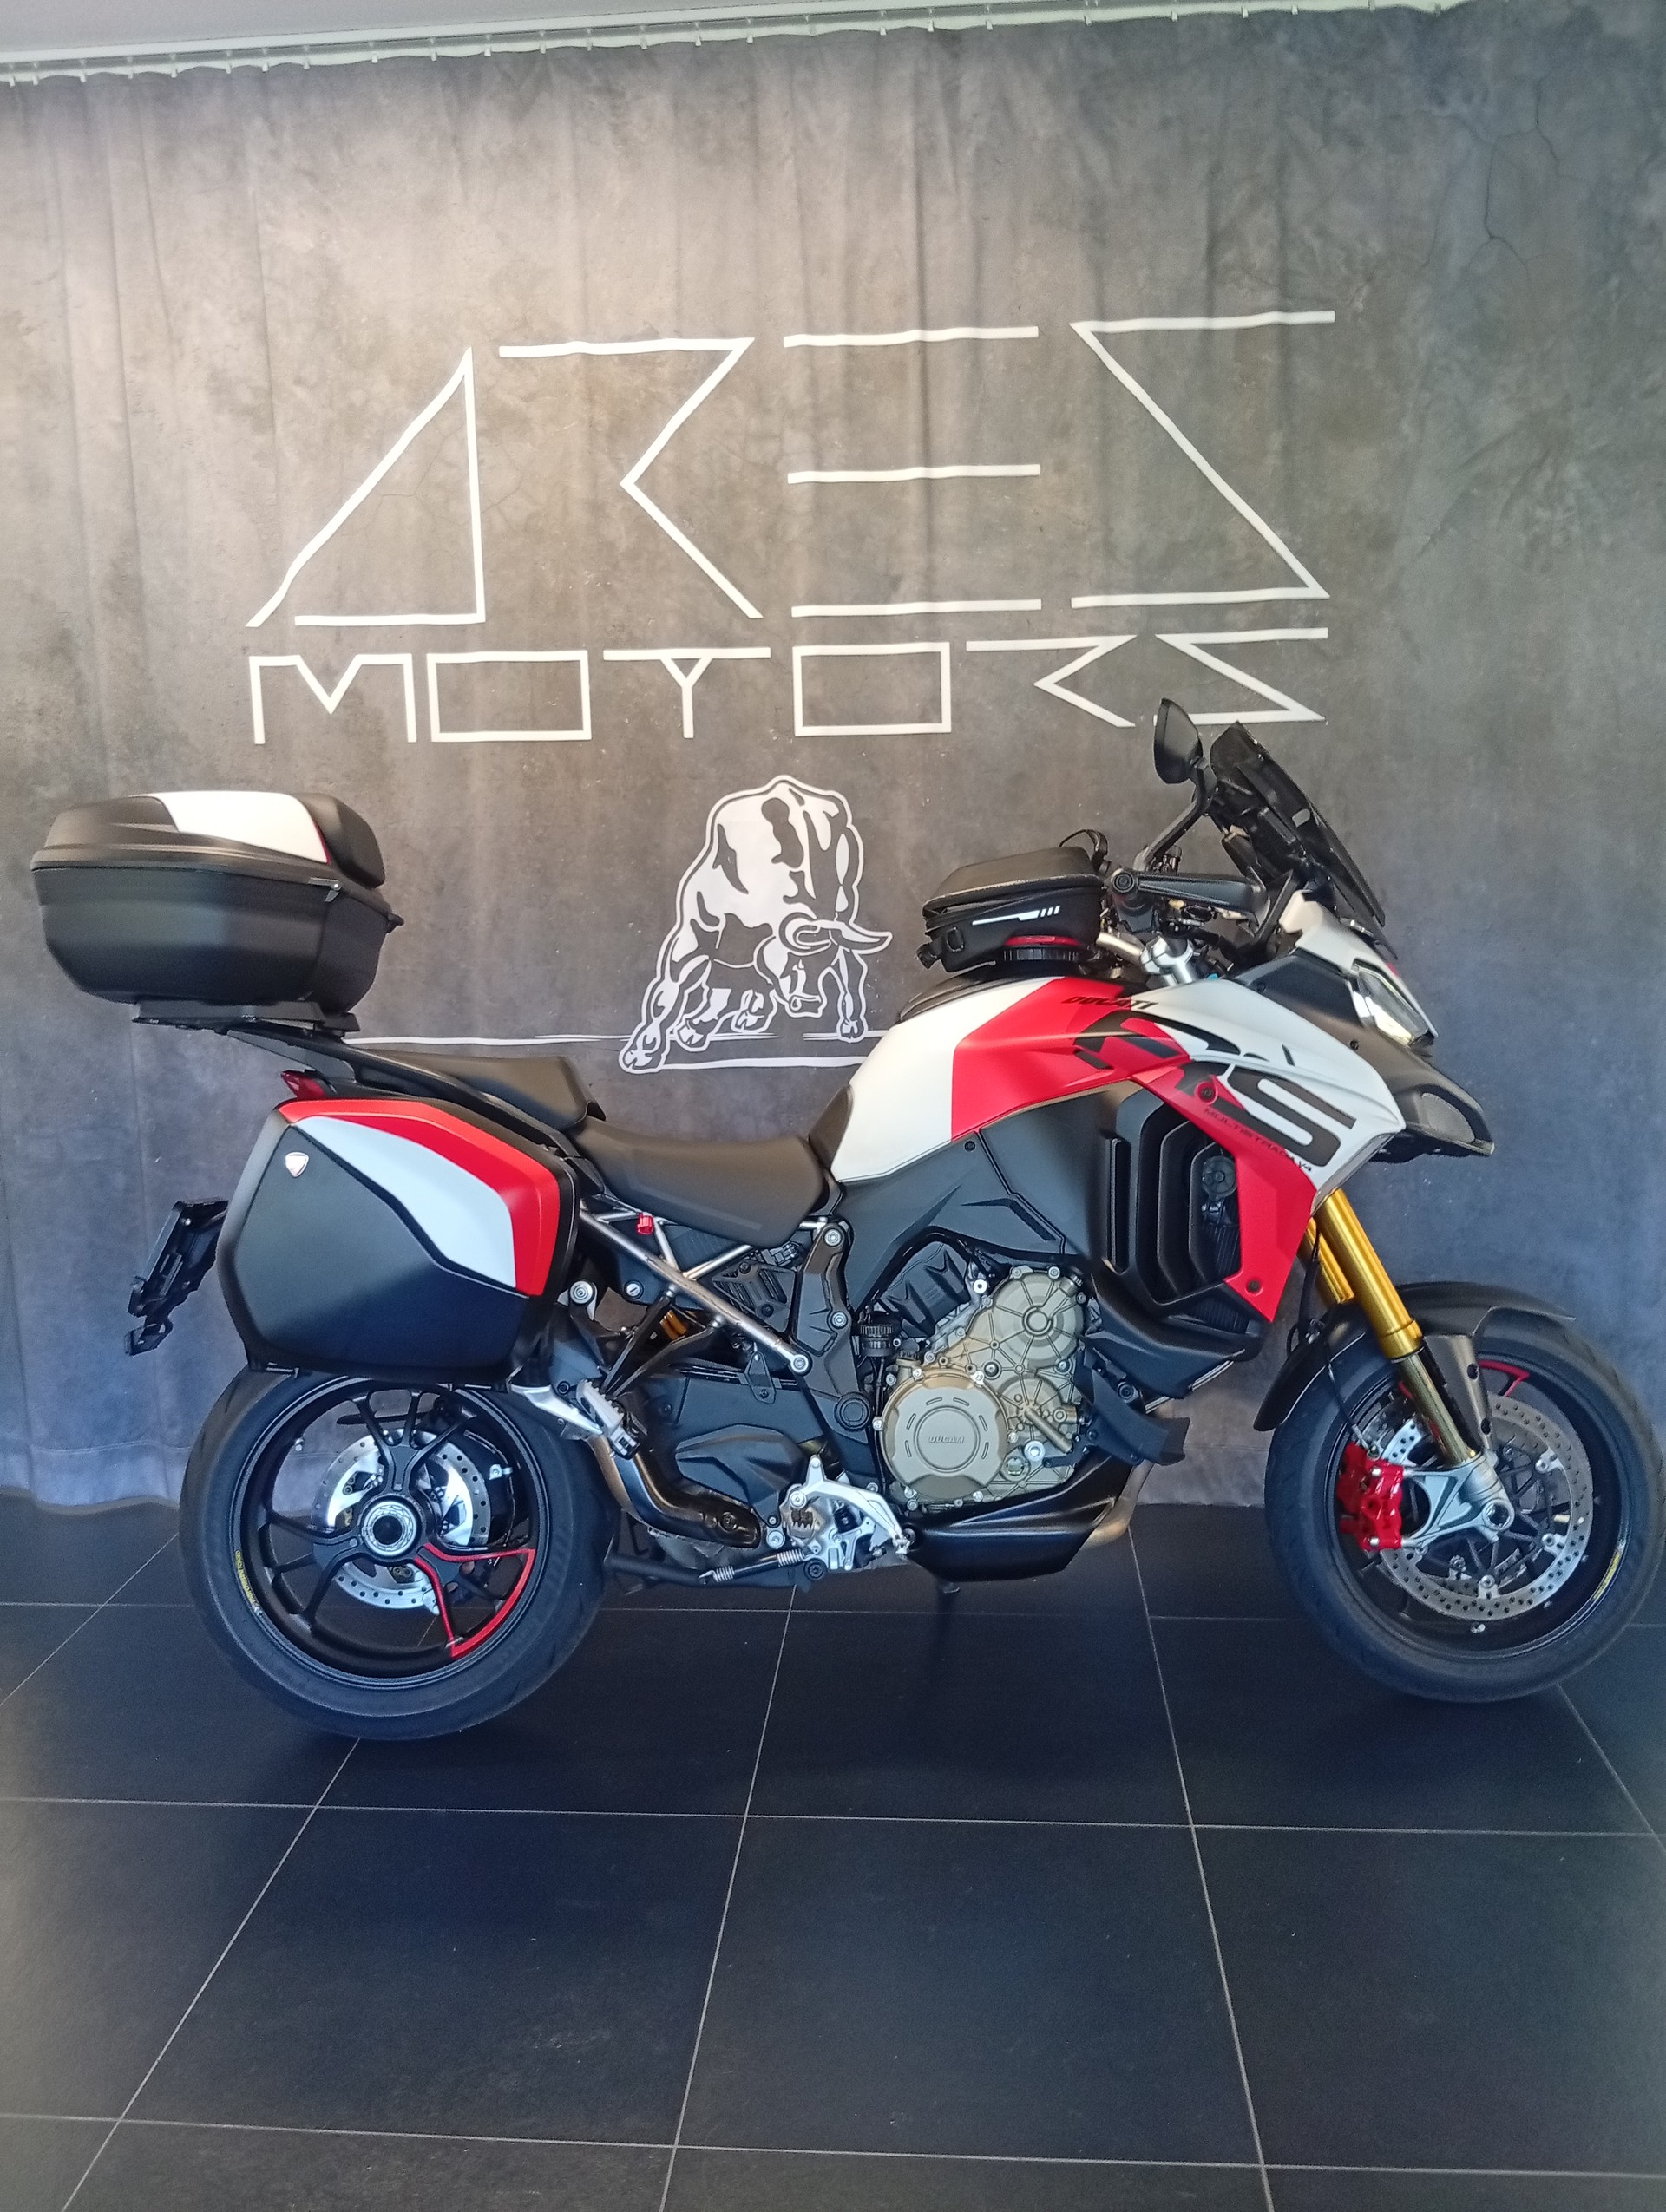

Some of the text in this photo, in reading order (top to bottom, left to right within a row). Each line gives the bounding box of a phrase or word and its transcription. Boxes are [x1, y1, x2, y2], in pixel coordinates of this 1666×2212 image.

[246, 311, 1335, 627] ARES
[249, 628, 1328, 745] MOTORS
[1060, 996, 1159, 1010] DUCATI
[1204, 1108, 1295, 1162] MULTISTRADA
[928, 1436, 965, 1444] DUCATI
